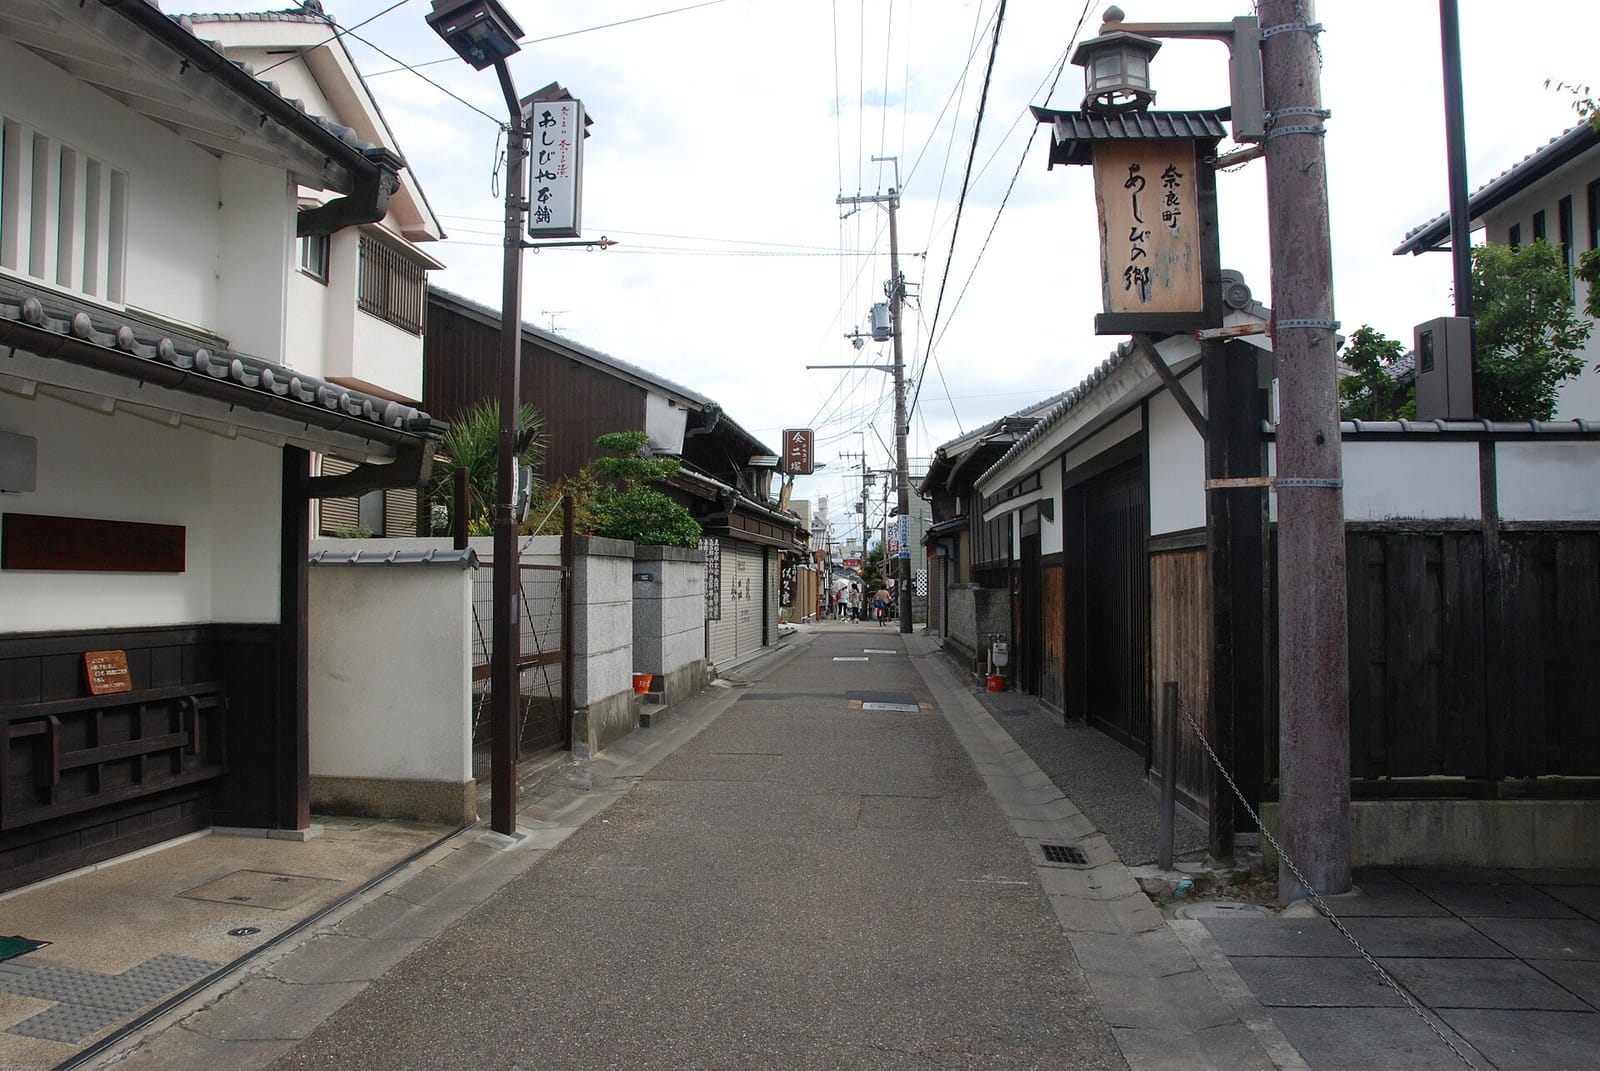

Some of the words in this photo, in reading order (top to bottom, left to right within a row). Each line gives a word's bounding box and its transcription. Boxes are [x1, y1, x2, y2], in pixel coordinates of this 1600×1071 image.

[1124, 163, 1151, 304] あしびの郷
[1160, 163, 1183, 229] 奈良町
